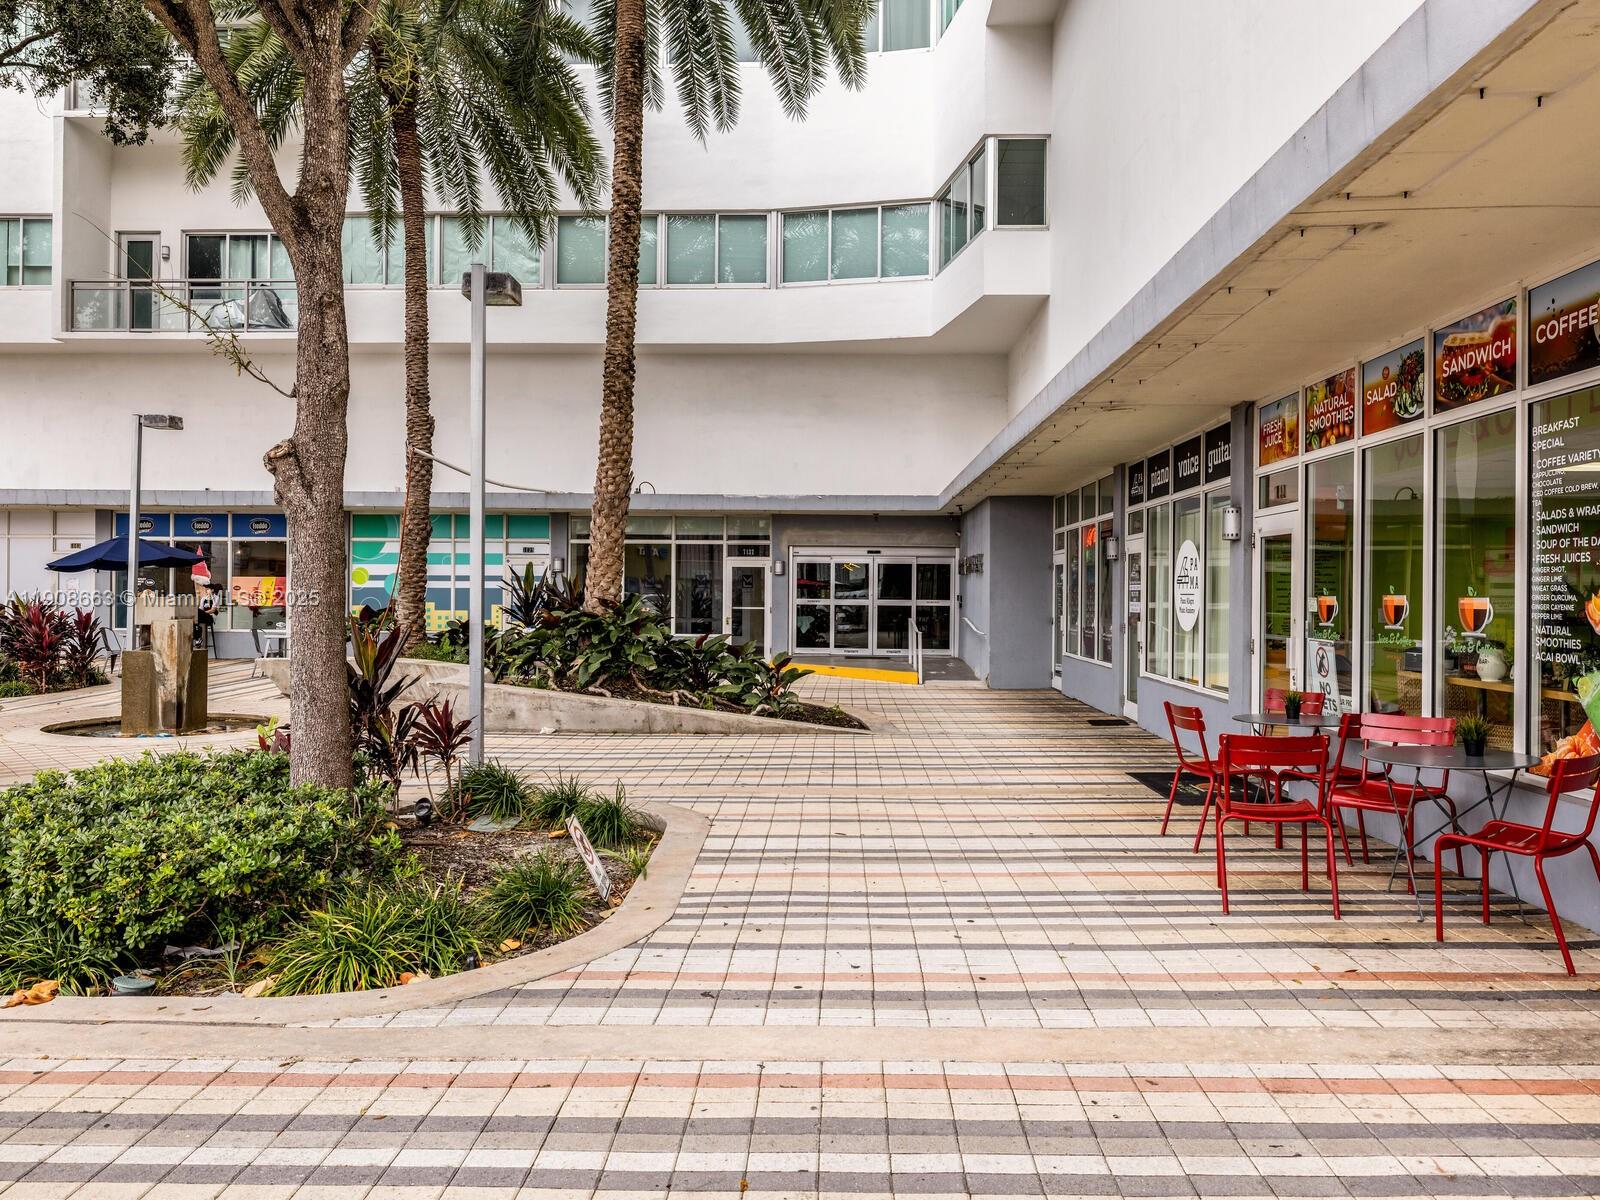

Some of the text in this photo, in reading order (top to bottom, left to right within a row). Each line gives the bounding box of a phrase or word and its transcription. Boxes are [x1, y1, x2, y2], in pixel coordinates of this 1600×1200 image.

[1535, 303, 1599, 344] COFFEE
[1442, 337, 1511, 378] SANDWICH
[1366, 381, 1397, 406] SALAD
[1313, 392, 1349, 415] NATURAL
[1309, 405, 1354, 432] SMOOTHIES
[1532, 416, 1580, 436] BREAKFAST
[1263, 419, 1282, 436] FRESH
[1264, 431, 1283, 448] JUICE
[1532, 437, 1565, 452] SPECIAL
[1178, 452, 1199, 478] voice
[1536, 455, 1566, 469] COFFEE
[1150, 465, 1169, 494] piano
[1532, 478, 1562, 488] CHOCOLATE
[1544, 487, 1564, 495] COFFEE
[1564, 484, 1580, 493] COLD
[1536, 508, 1567, 521] SALADS
[1568, 508, 1575, 518] &
[1536, 523, 1579, 536] SANDWICH
[1536, 539, 1557, 550] SOUP
[1559, 538, 1571, 548] OF
[1572, 537, 1589, 547] THE
[1536, 552, 1591, 564] FRESH JUICES
[1536, 625, 1571, 636] NATURAL
[1536, 637, 1581, 650] SMOOTHIES
[1536, 652, 1581, 665] ACAI BOWL
[1319, 681, 1331, 695] NO
[1323, 697, 1337, 712] ETS
